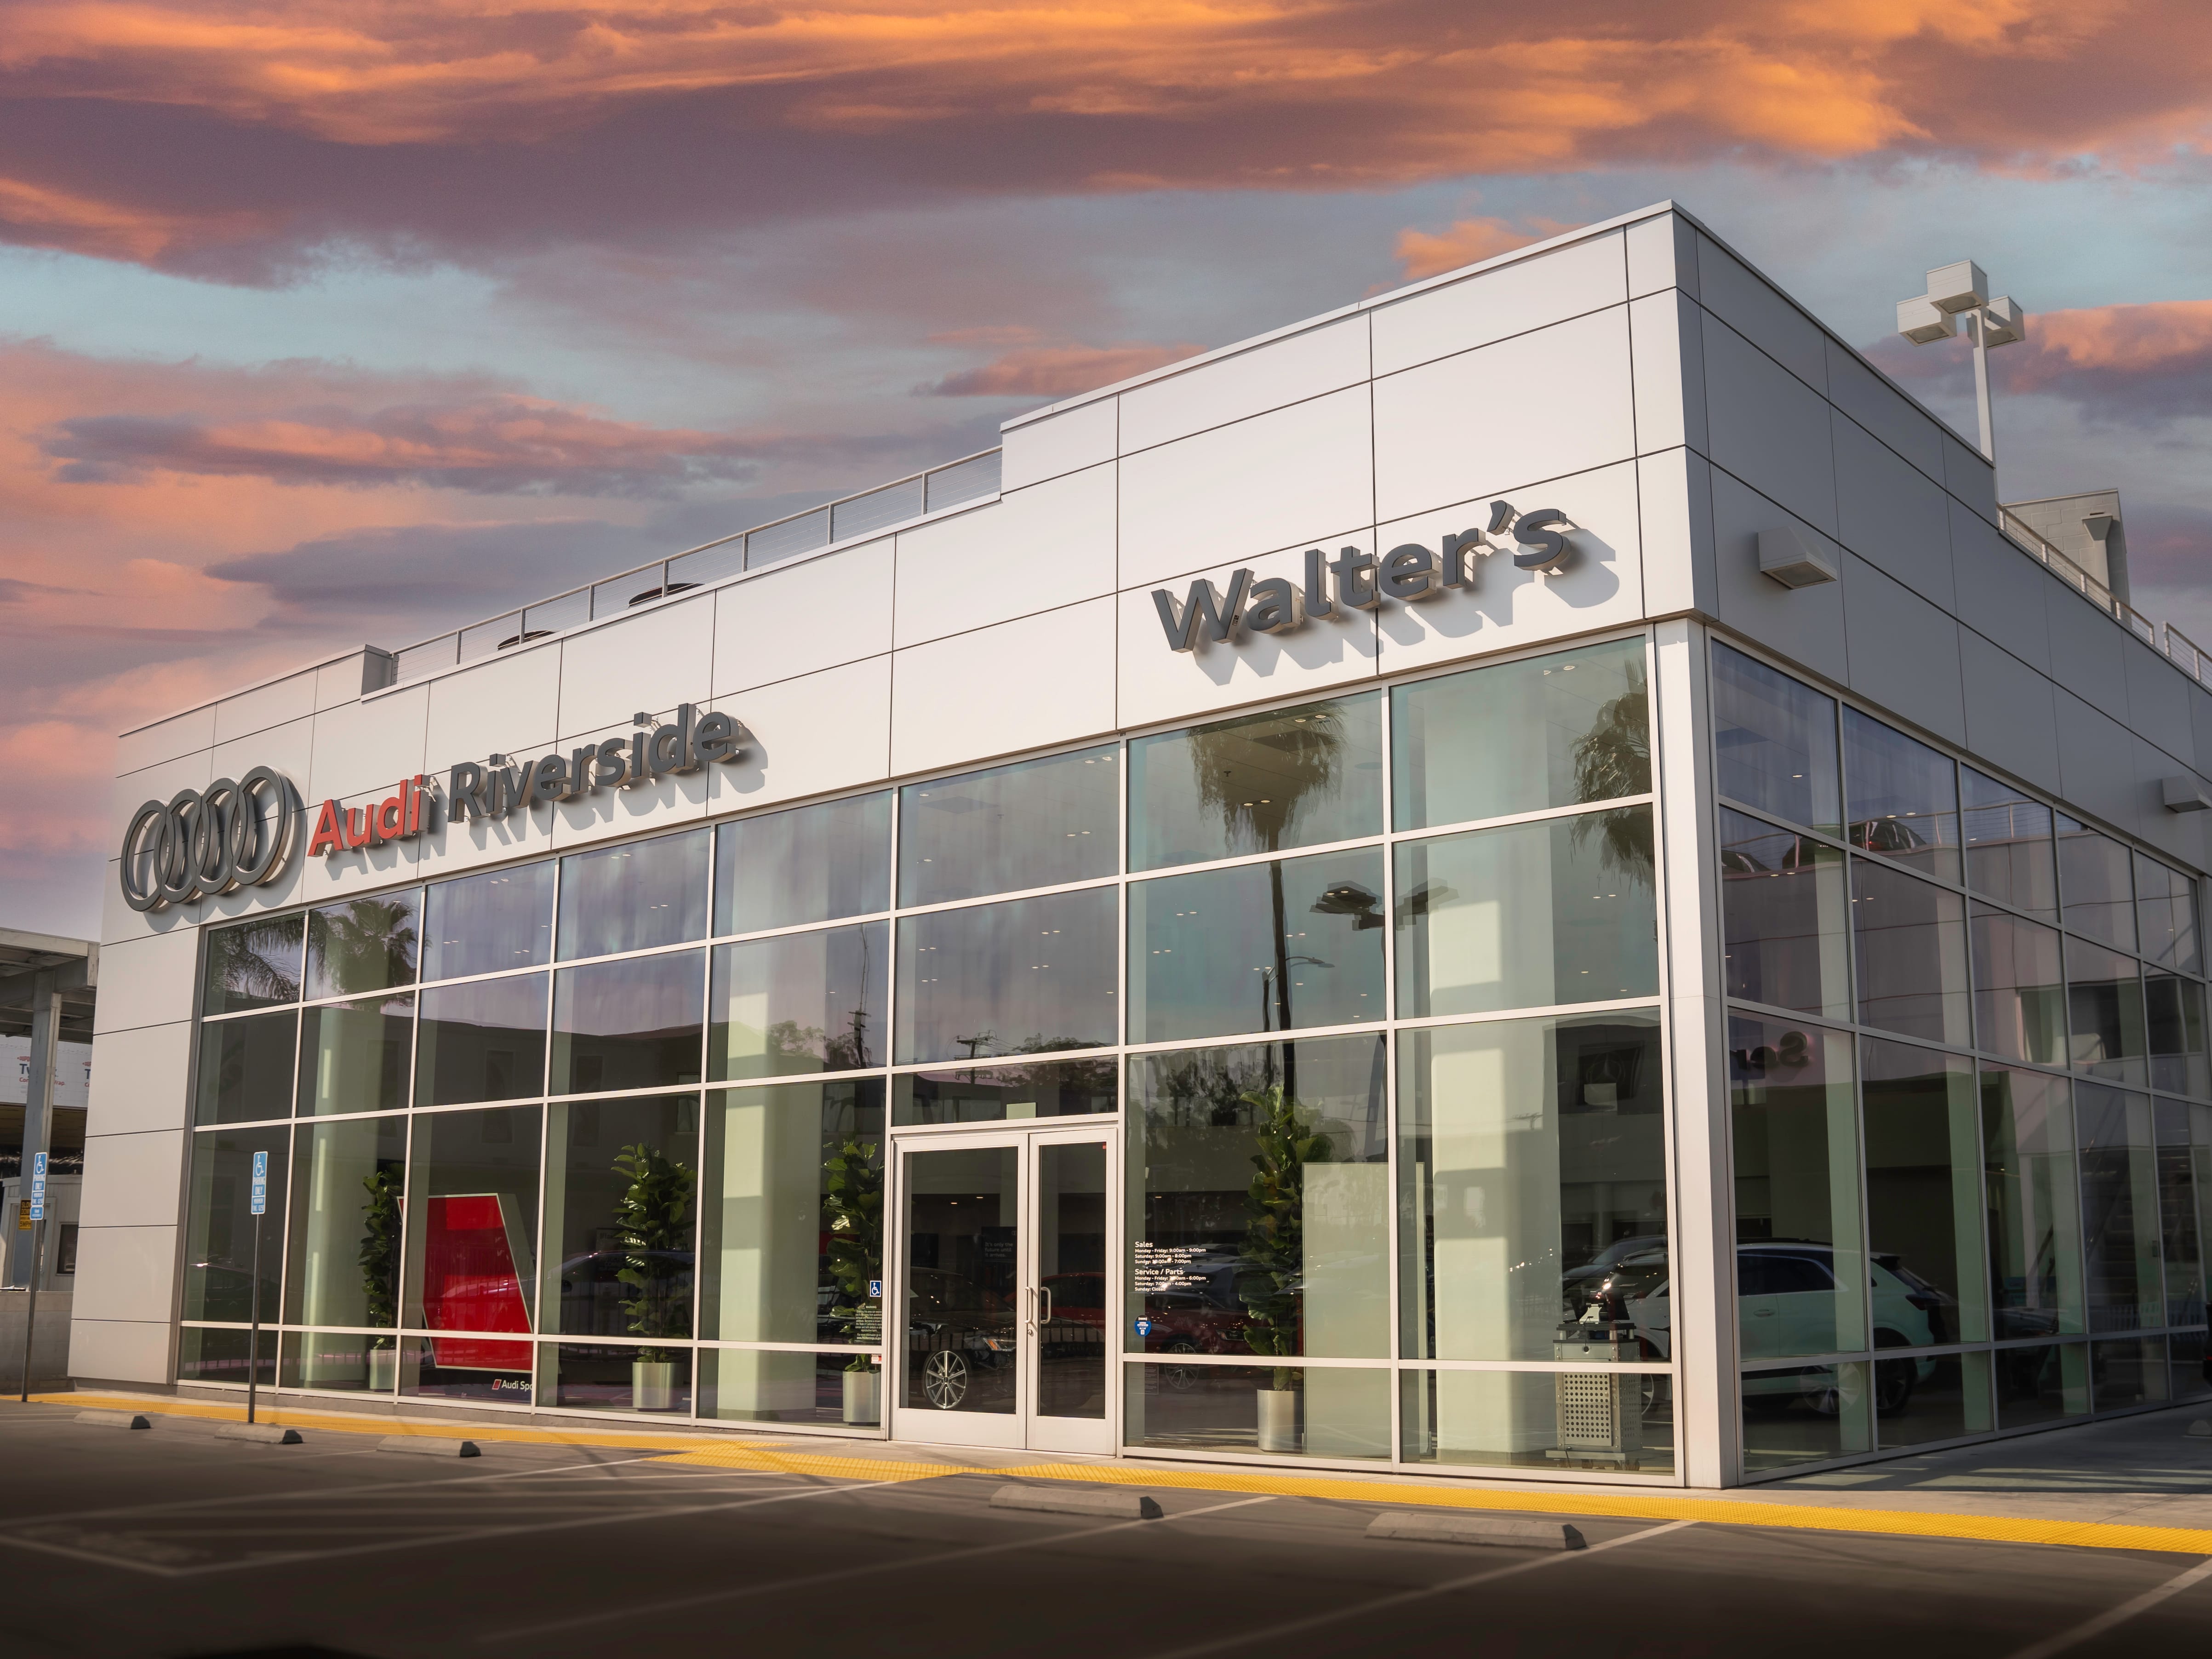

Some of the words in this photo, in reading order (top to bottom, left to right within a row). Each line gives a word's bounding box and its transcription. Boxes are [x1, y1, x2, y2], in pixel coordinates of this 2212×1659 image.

[1151, 500, 1570, 653] Walter's
[308, 774, 429, 857] Audi
[448, 703, 739, 824] Riverside
[502, 1380, 519, 1389] Audi
[520, 1381, 532, 1392] Spo
